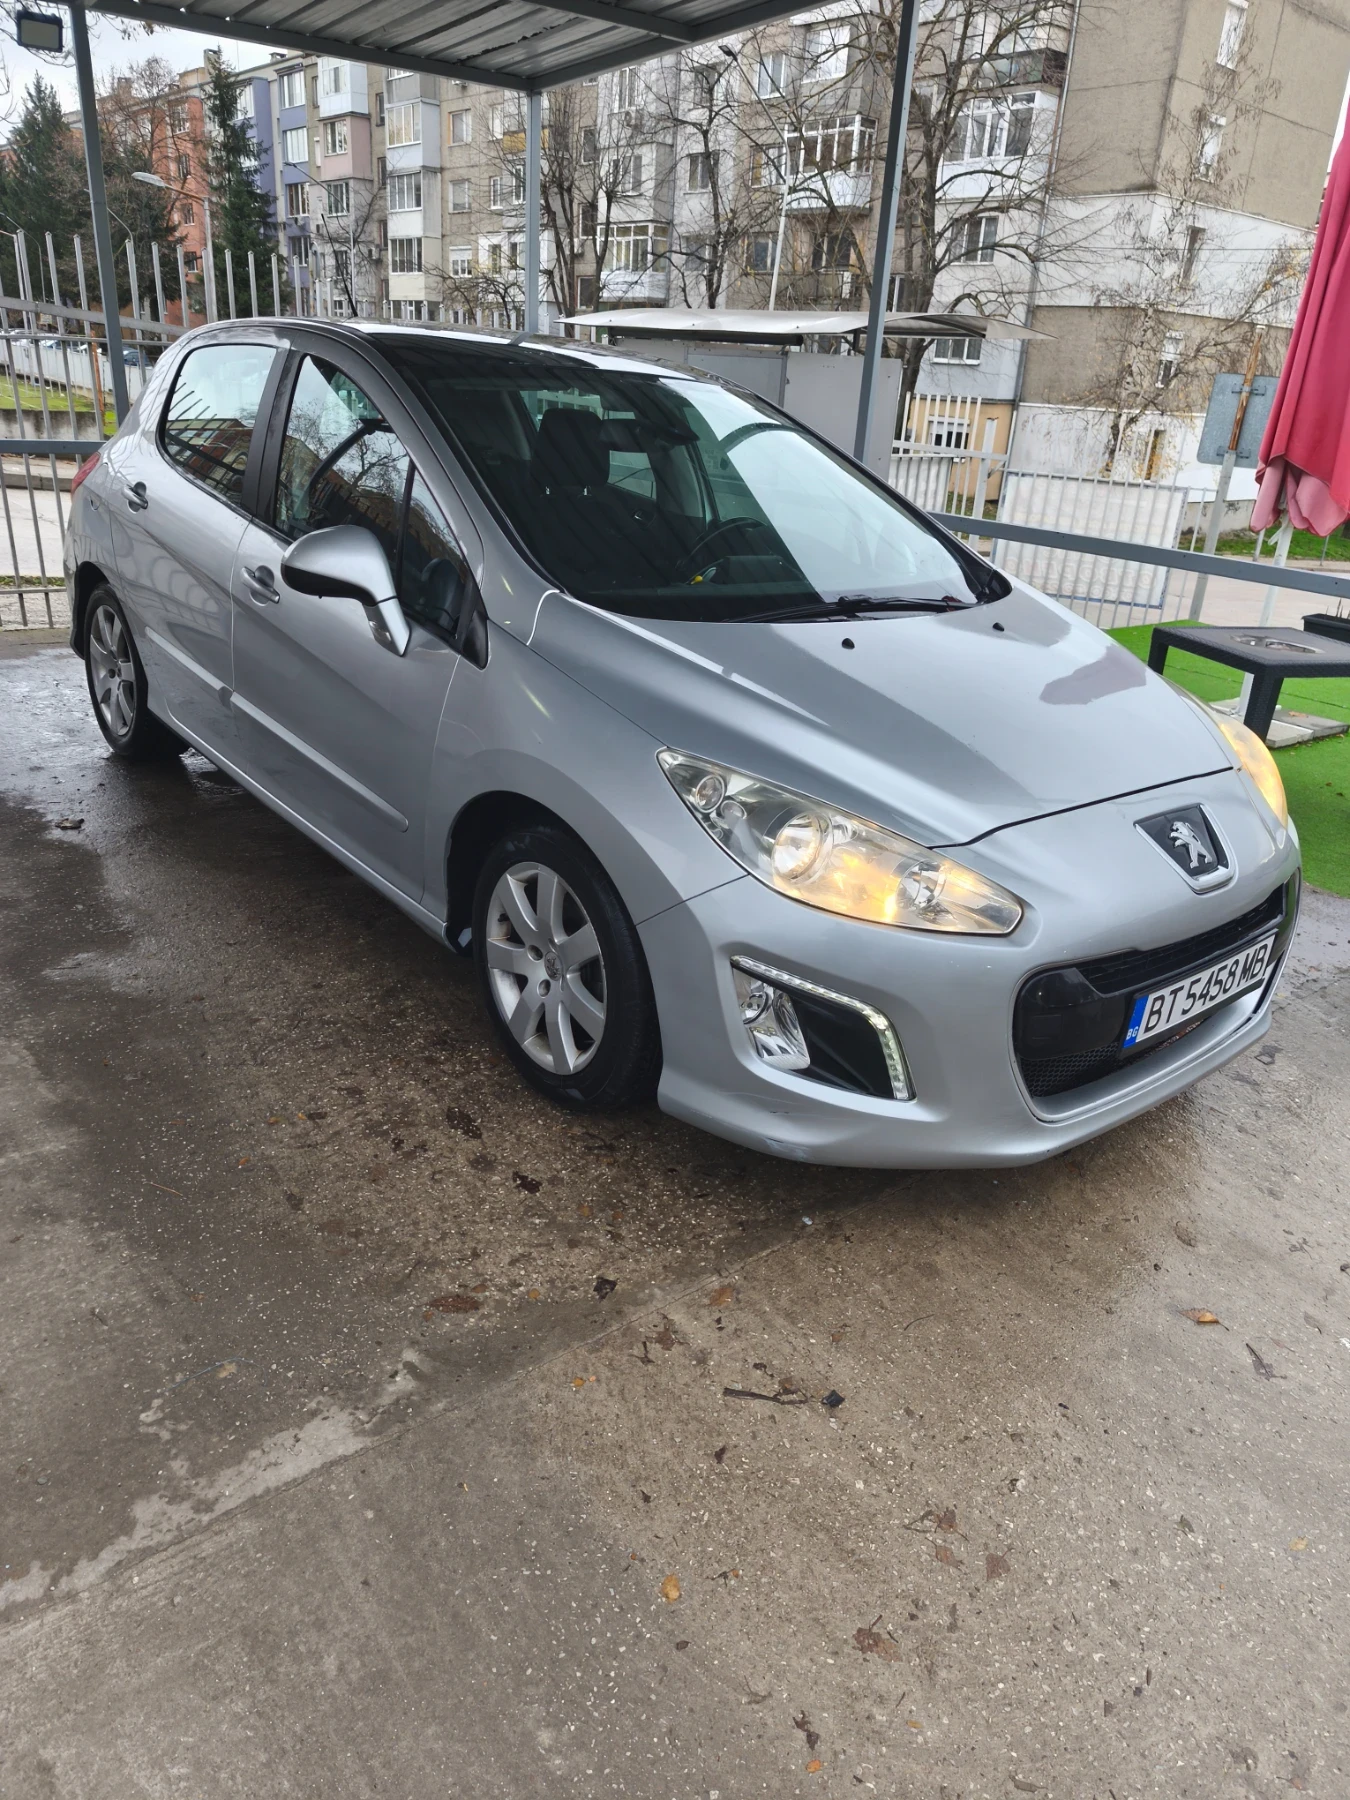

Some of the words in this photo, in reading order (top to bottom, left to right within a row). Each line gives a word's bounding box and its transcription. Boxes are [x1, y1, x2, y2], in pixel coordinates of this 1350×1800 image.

[1144, 985, 1185, 1034] BT
[1181, 958, 1239, 1016] 5458
[1237, 943, 1268, 988] MB
[1126, 1026, 1139, 1041] BG
